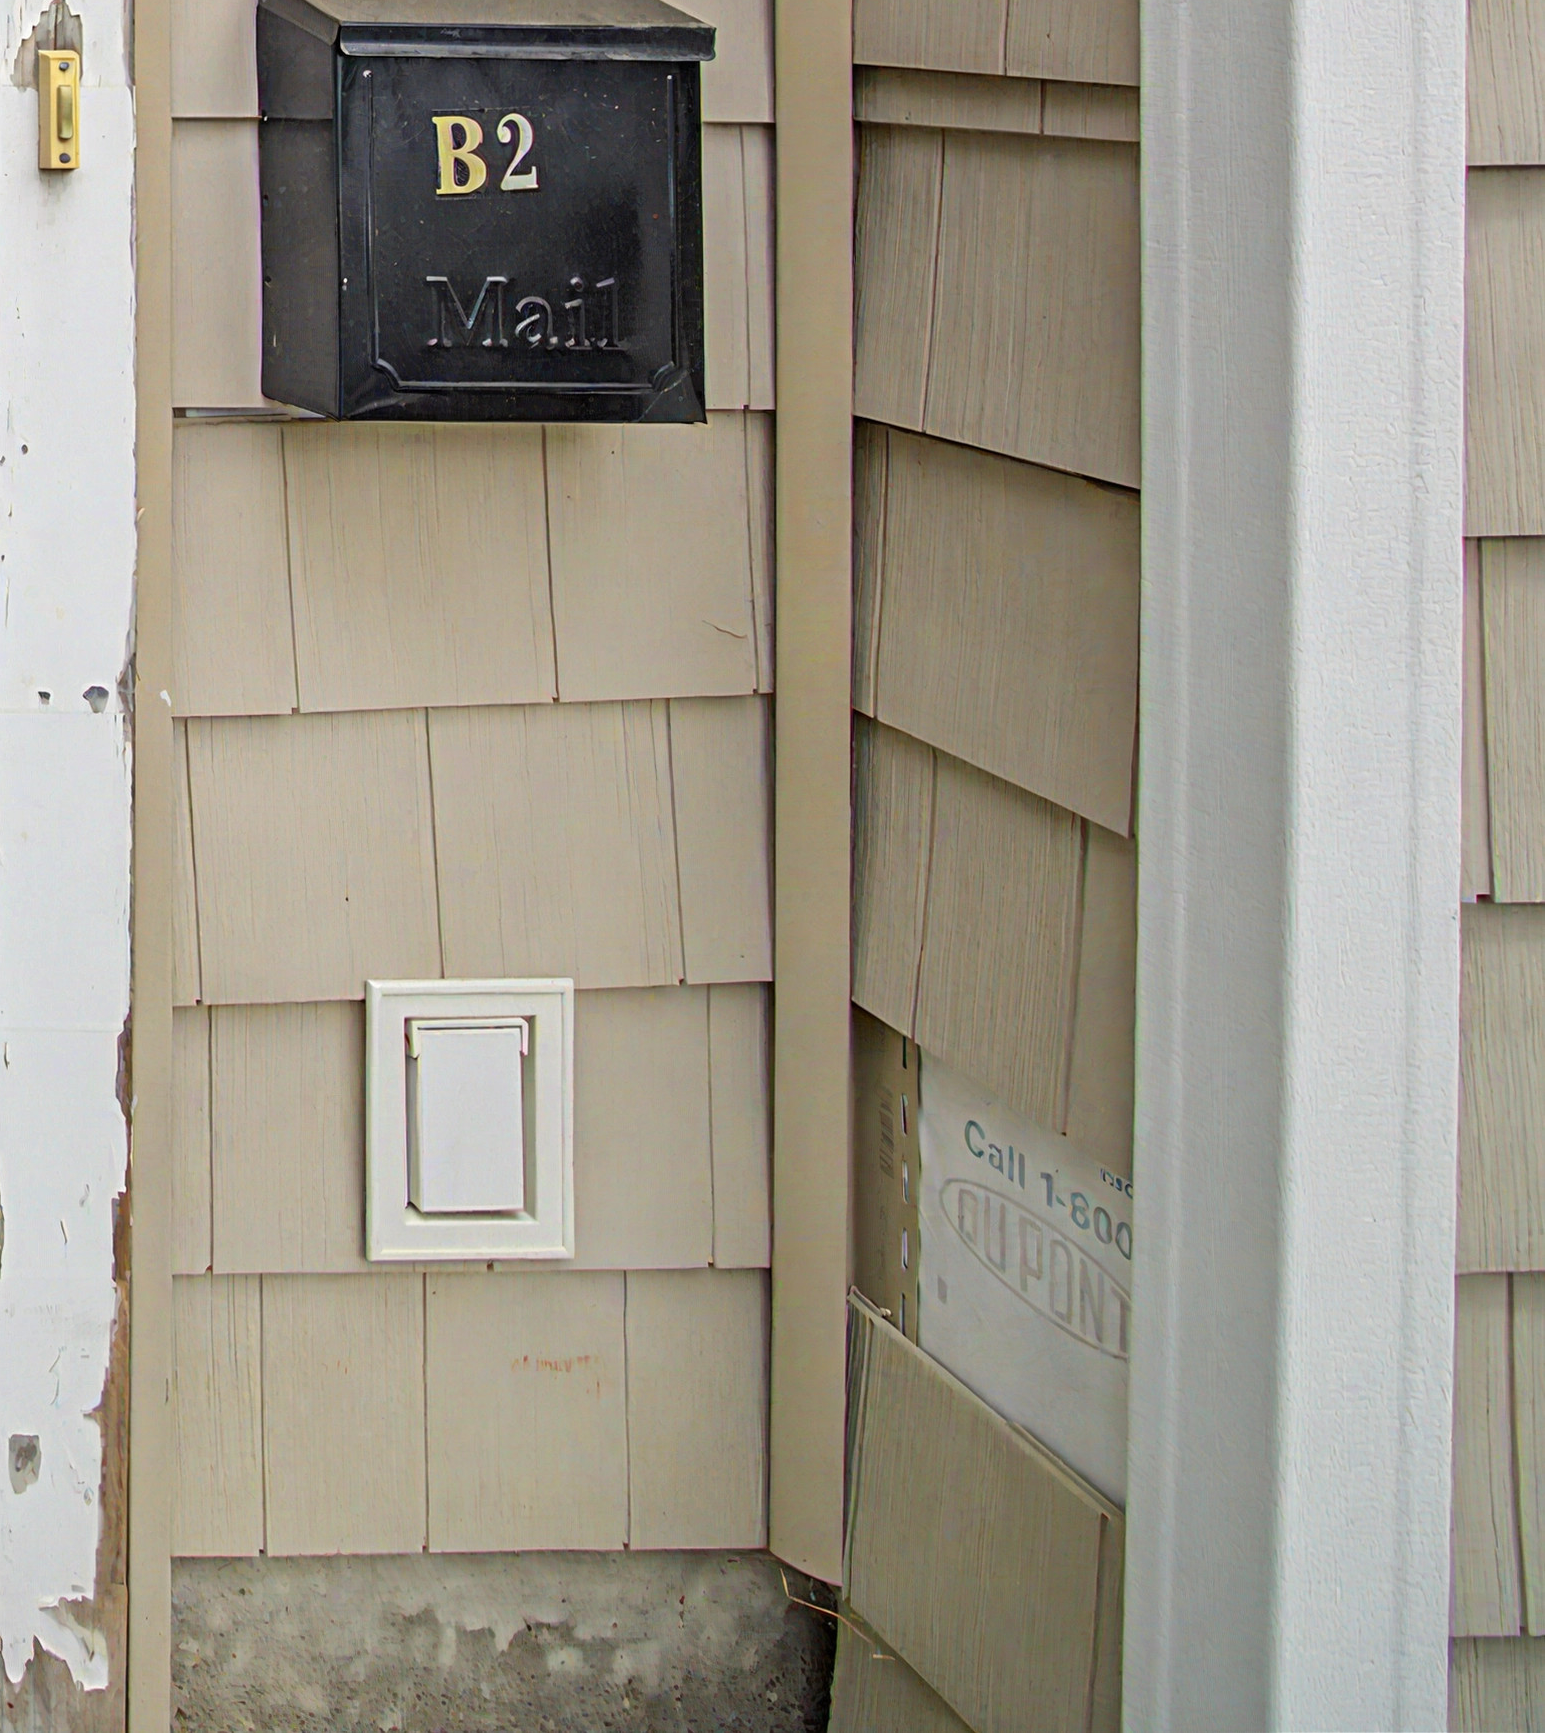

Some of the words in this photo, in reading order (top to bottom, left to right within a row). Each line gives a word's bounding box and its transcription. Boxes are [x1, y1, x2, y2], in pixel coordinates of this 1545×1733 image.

[432, 112, 539, 195] B2
[426, 275, 629, 351] Mail
[964, 1120, 1026, 1190] Call
